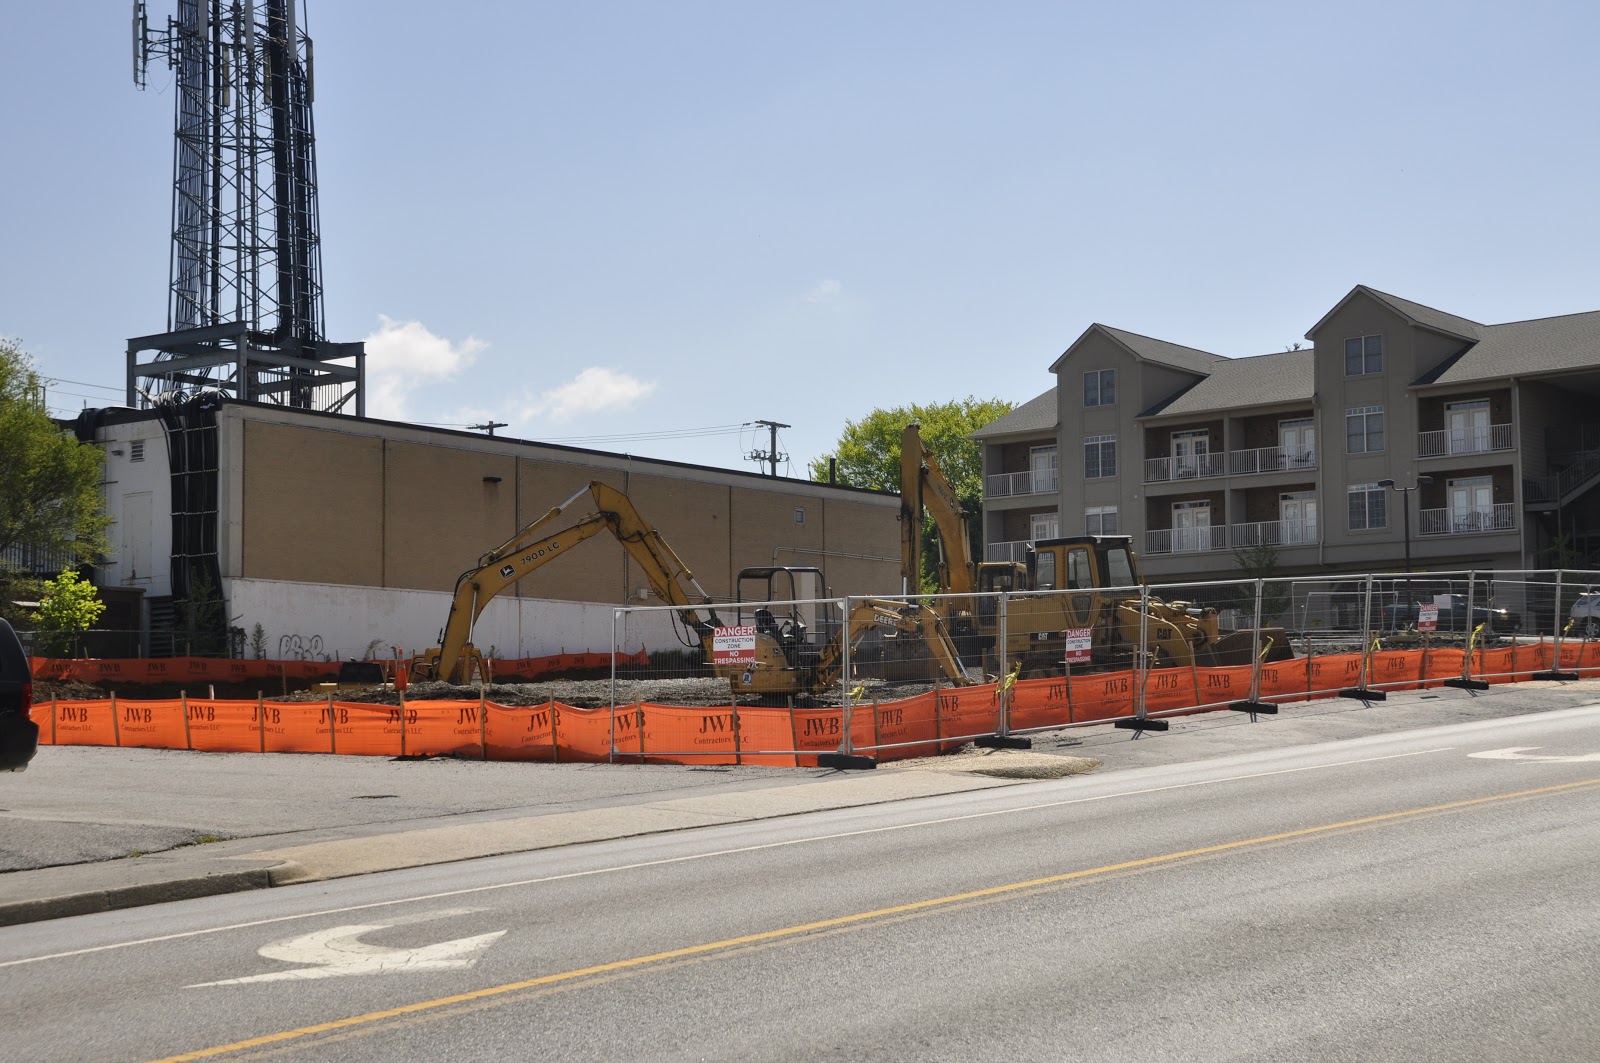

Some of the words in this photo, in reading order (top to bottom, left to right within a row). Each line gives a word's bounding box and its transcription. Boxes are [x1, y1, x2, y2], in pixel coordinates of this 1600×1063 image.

[874, 613, 898, 627] DEERE
[714, 626, 754, 637] DANGER
[1038, 632, 1049, 640] CAT
[1067, 629, 1091, 638] DANGER
[1157, 628, 1172, 640] CAT
[713, 656, 755, 665] TRESPASSING
[1103, 678, 1128, 696] JWB
[1155, 674, 1178, 689] JWB
[1207, 674, 1230, 688] JWB
[60, 707, 88, 722] JWB
[124, 708, 152, 723] JWB
[187, 705, 215, 721] JWB
[319, 708, 348, 724] JWB
[880, 708, 902, 729] JWB
[803, 717, 839, 736] JWB
[693, 737, 731, 745] Contractors
